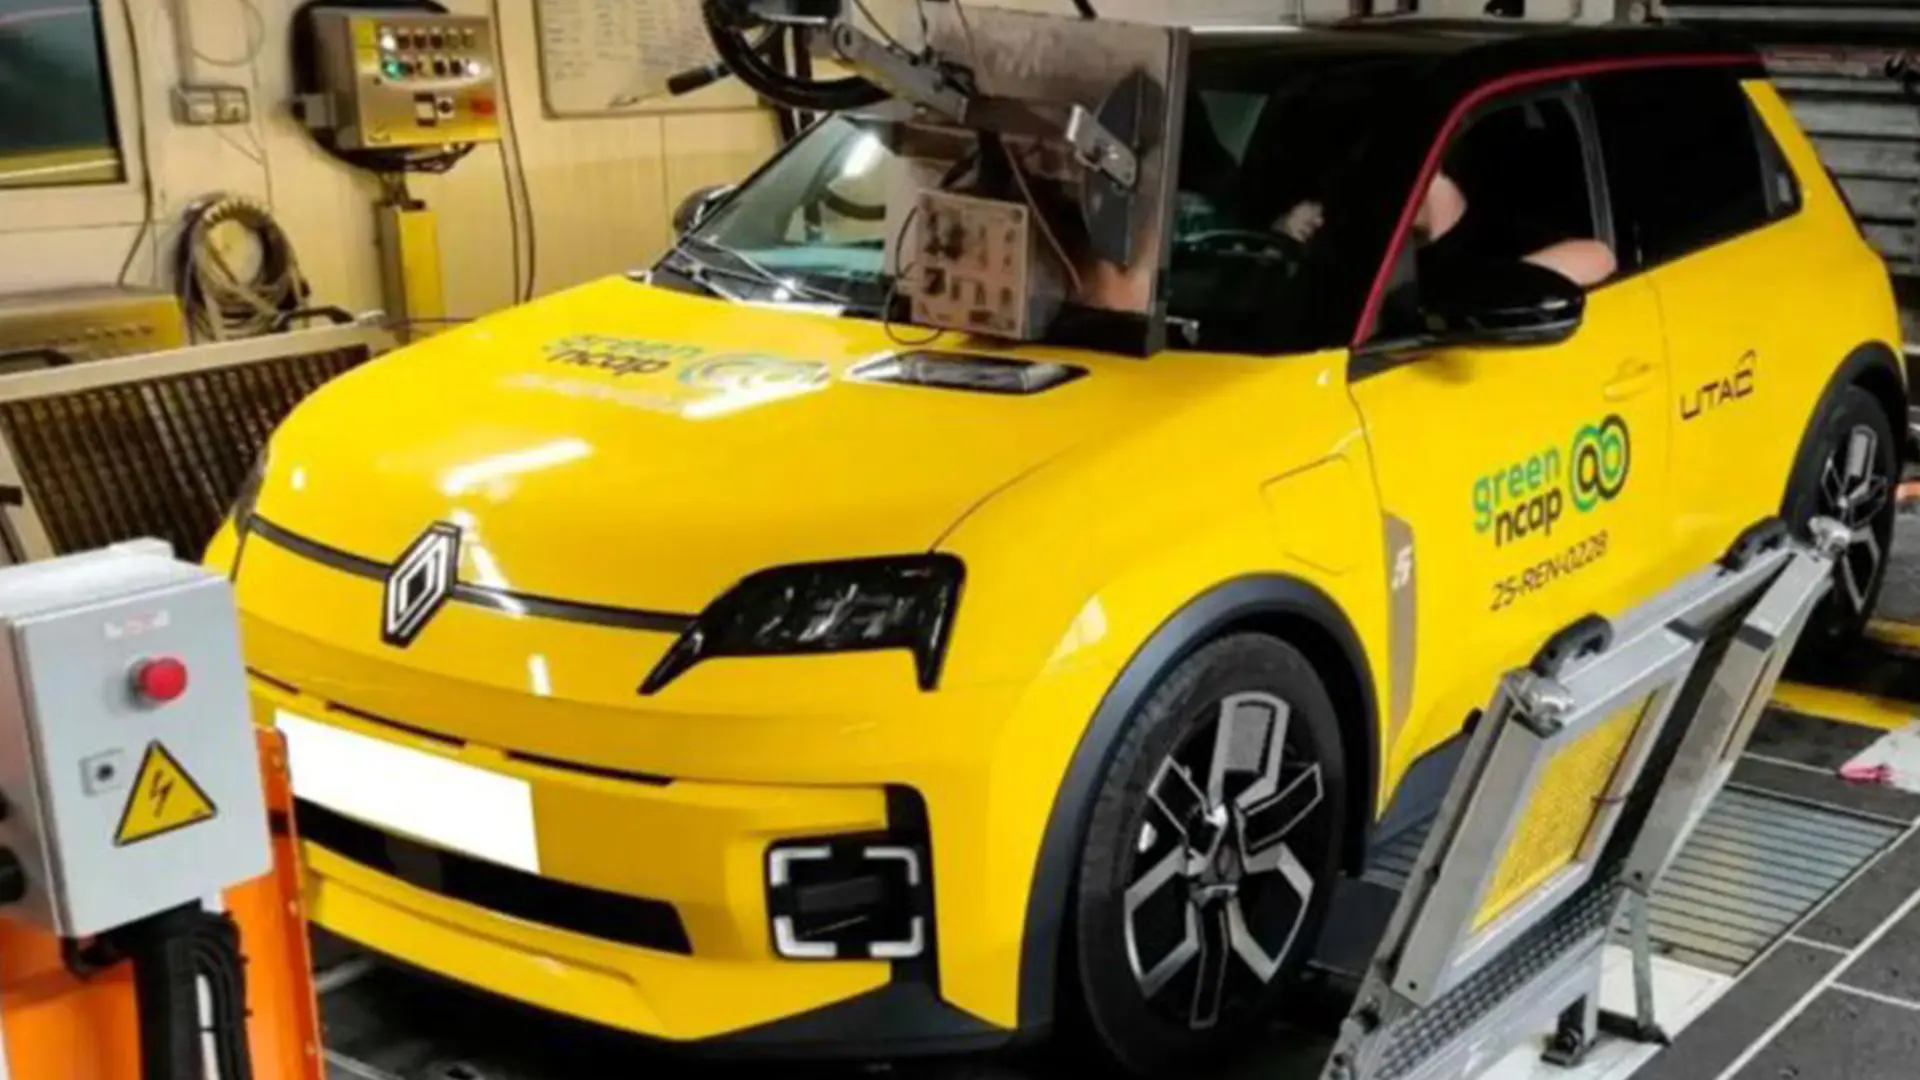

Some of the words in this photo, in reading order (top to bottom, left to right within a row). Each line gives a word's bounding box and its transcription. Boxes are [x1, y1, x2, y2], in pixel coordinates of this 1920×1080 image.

[546, 350, 670, 376] ncap
[1680, 366, 1754, 420] UTAC
[1473, 446, 1561, 533] green
[1495, 487, 1563, 547] ncap
[1489, 529, 1609, 611] 25-REN-0228
